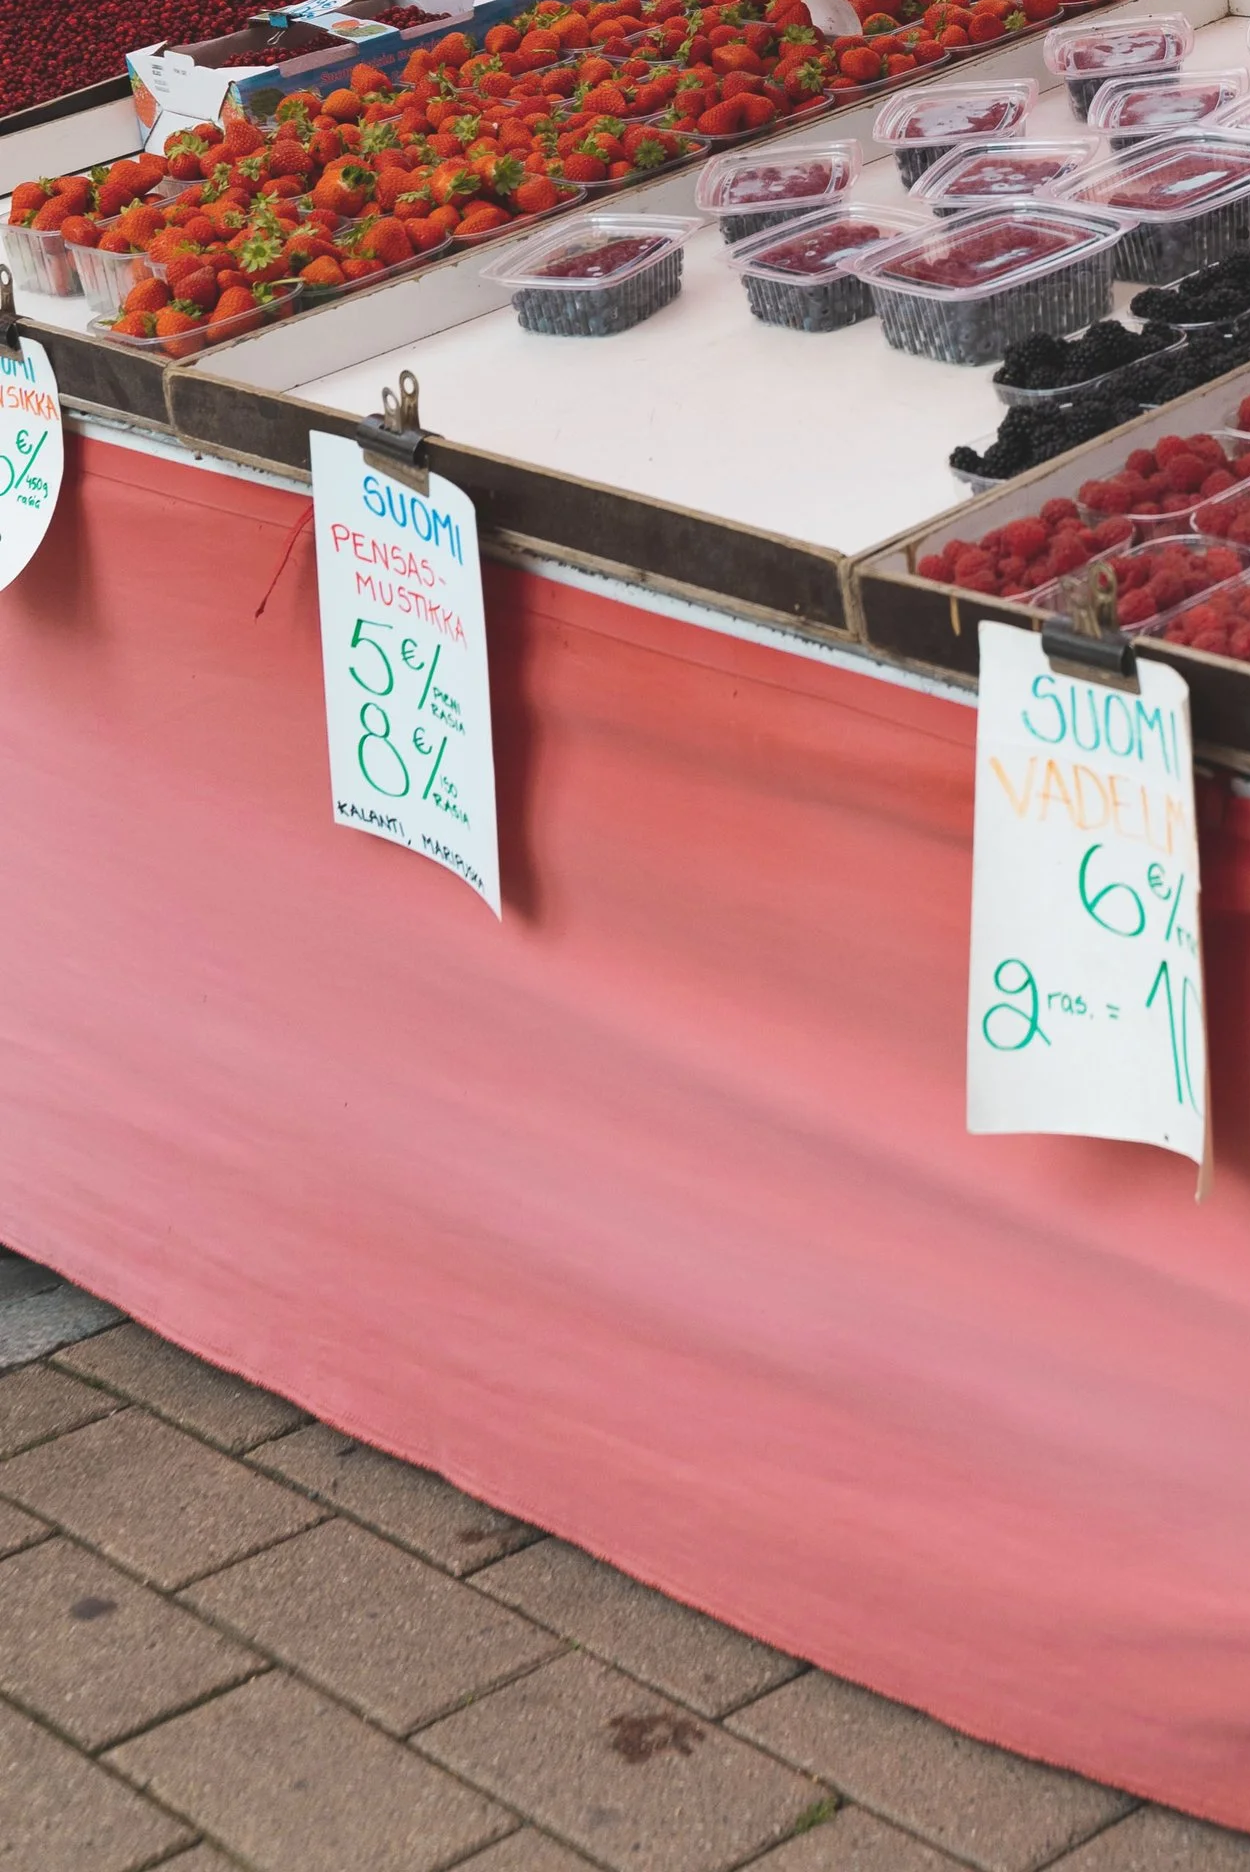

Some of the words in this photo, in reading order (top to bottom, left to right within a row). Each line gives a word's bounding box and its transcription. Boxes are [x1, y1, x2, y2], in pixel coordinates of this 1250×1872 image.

[331, 523, 447, 587] PENSAS-
[363, 475, 464, 566] SUOMI
[355, 571, 468, 649] MUSTIKKA
[1021, 674, 1182, 782] SUOMI
[432, 792, 472, 830] RASIA
